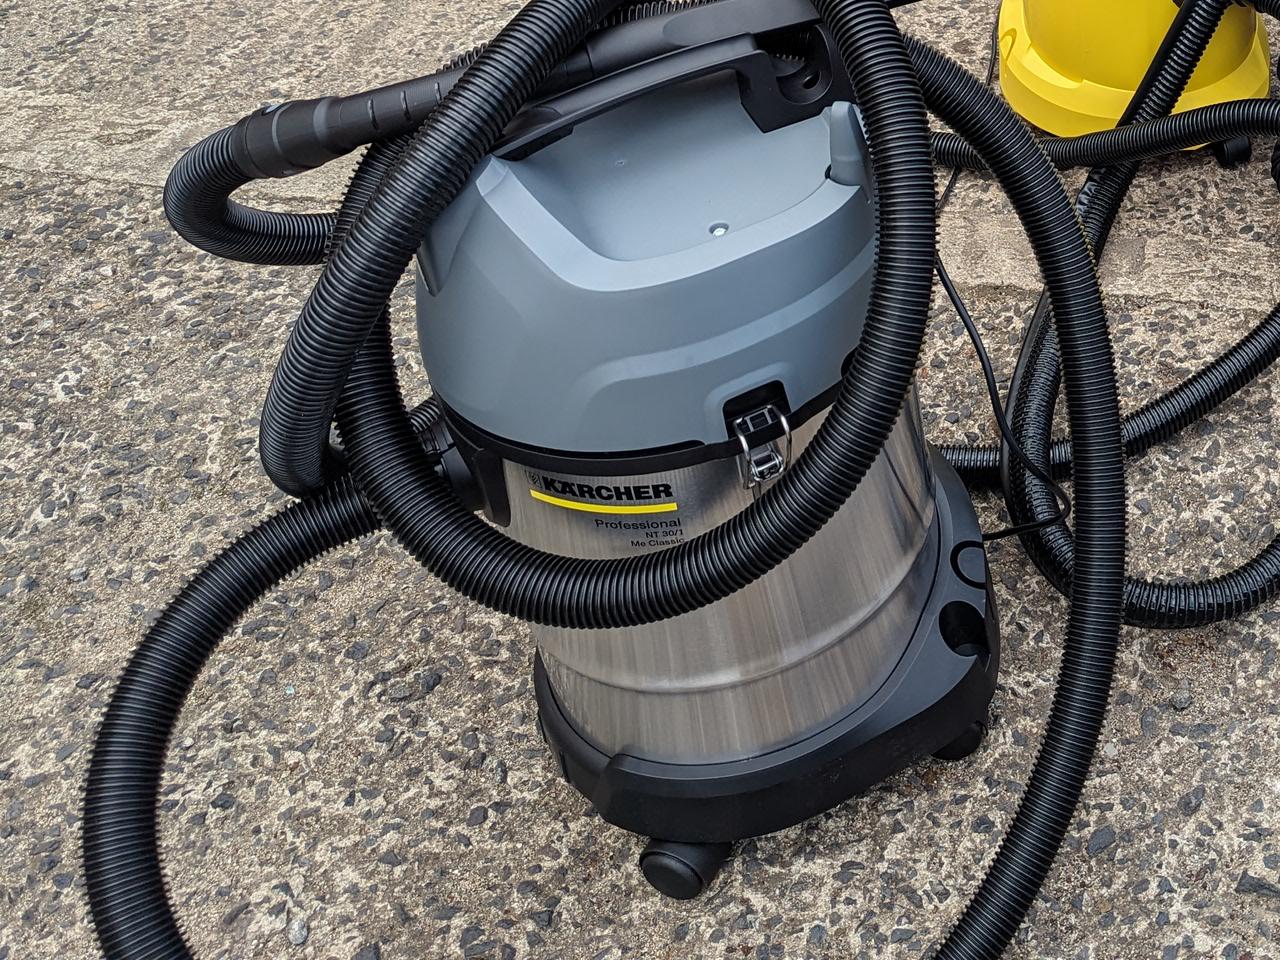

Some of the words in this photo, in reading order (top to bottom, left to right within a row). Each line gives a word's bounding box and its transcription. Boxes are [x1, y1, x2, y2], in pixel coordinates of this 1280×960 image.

[542, 476, 673, 501] KÄRCHER
[594, 517, 681, 530] Professional
[645, 531, 660, 539] NT
[662, 529, 683, 538] 30/1
[630, 540, 646, 548] Me
